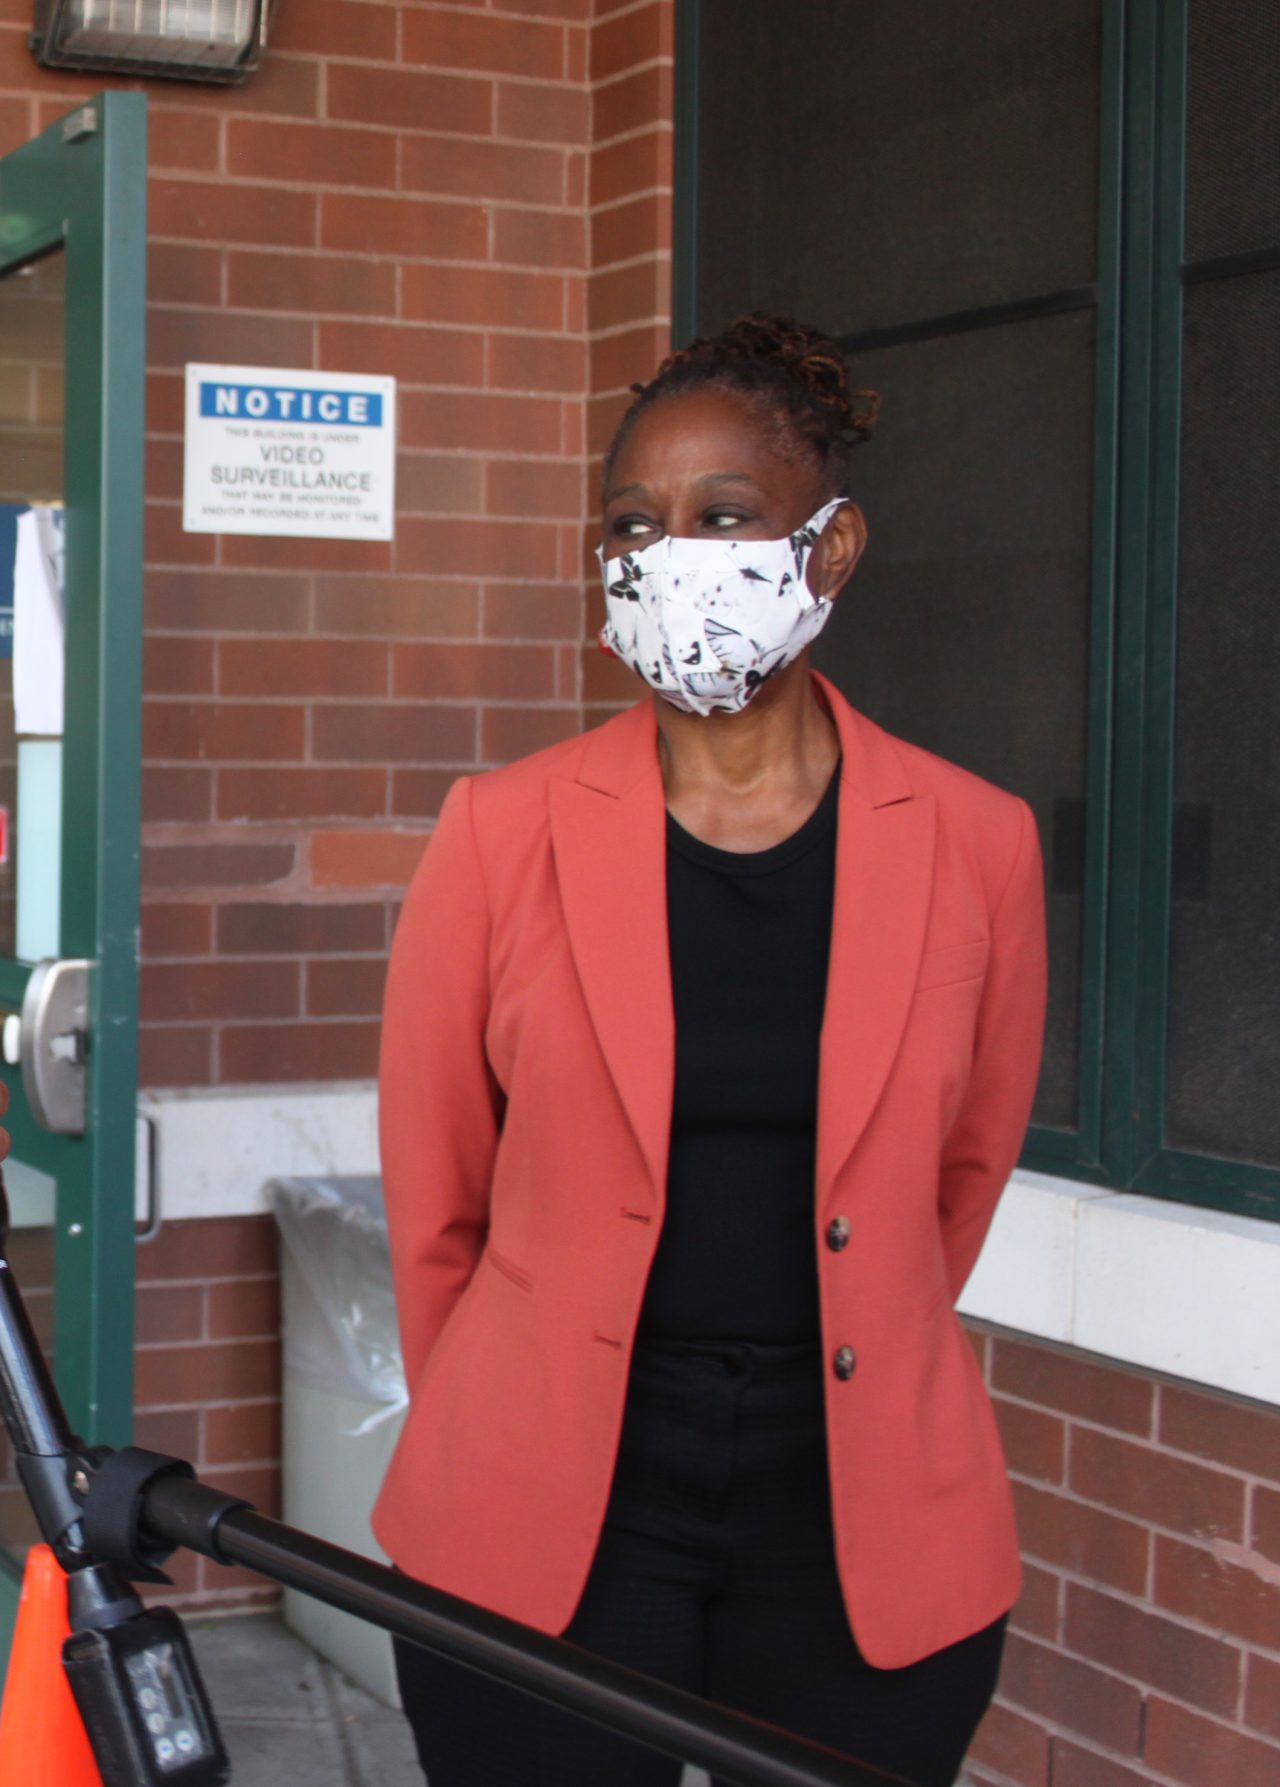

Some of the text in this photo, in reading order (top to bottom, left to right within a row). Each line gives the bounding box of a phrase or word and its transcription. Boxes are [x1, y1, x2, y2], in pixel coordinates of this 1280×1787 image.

[215, 387, 369, 423] NOTICE
[253, 428, 305, 441] BUILDING
[259, 445, 324, 465] VIDEO
[210, 465, 372, 491] SURVEILLANCE
